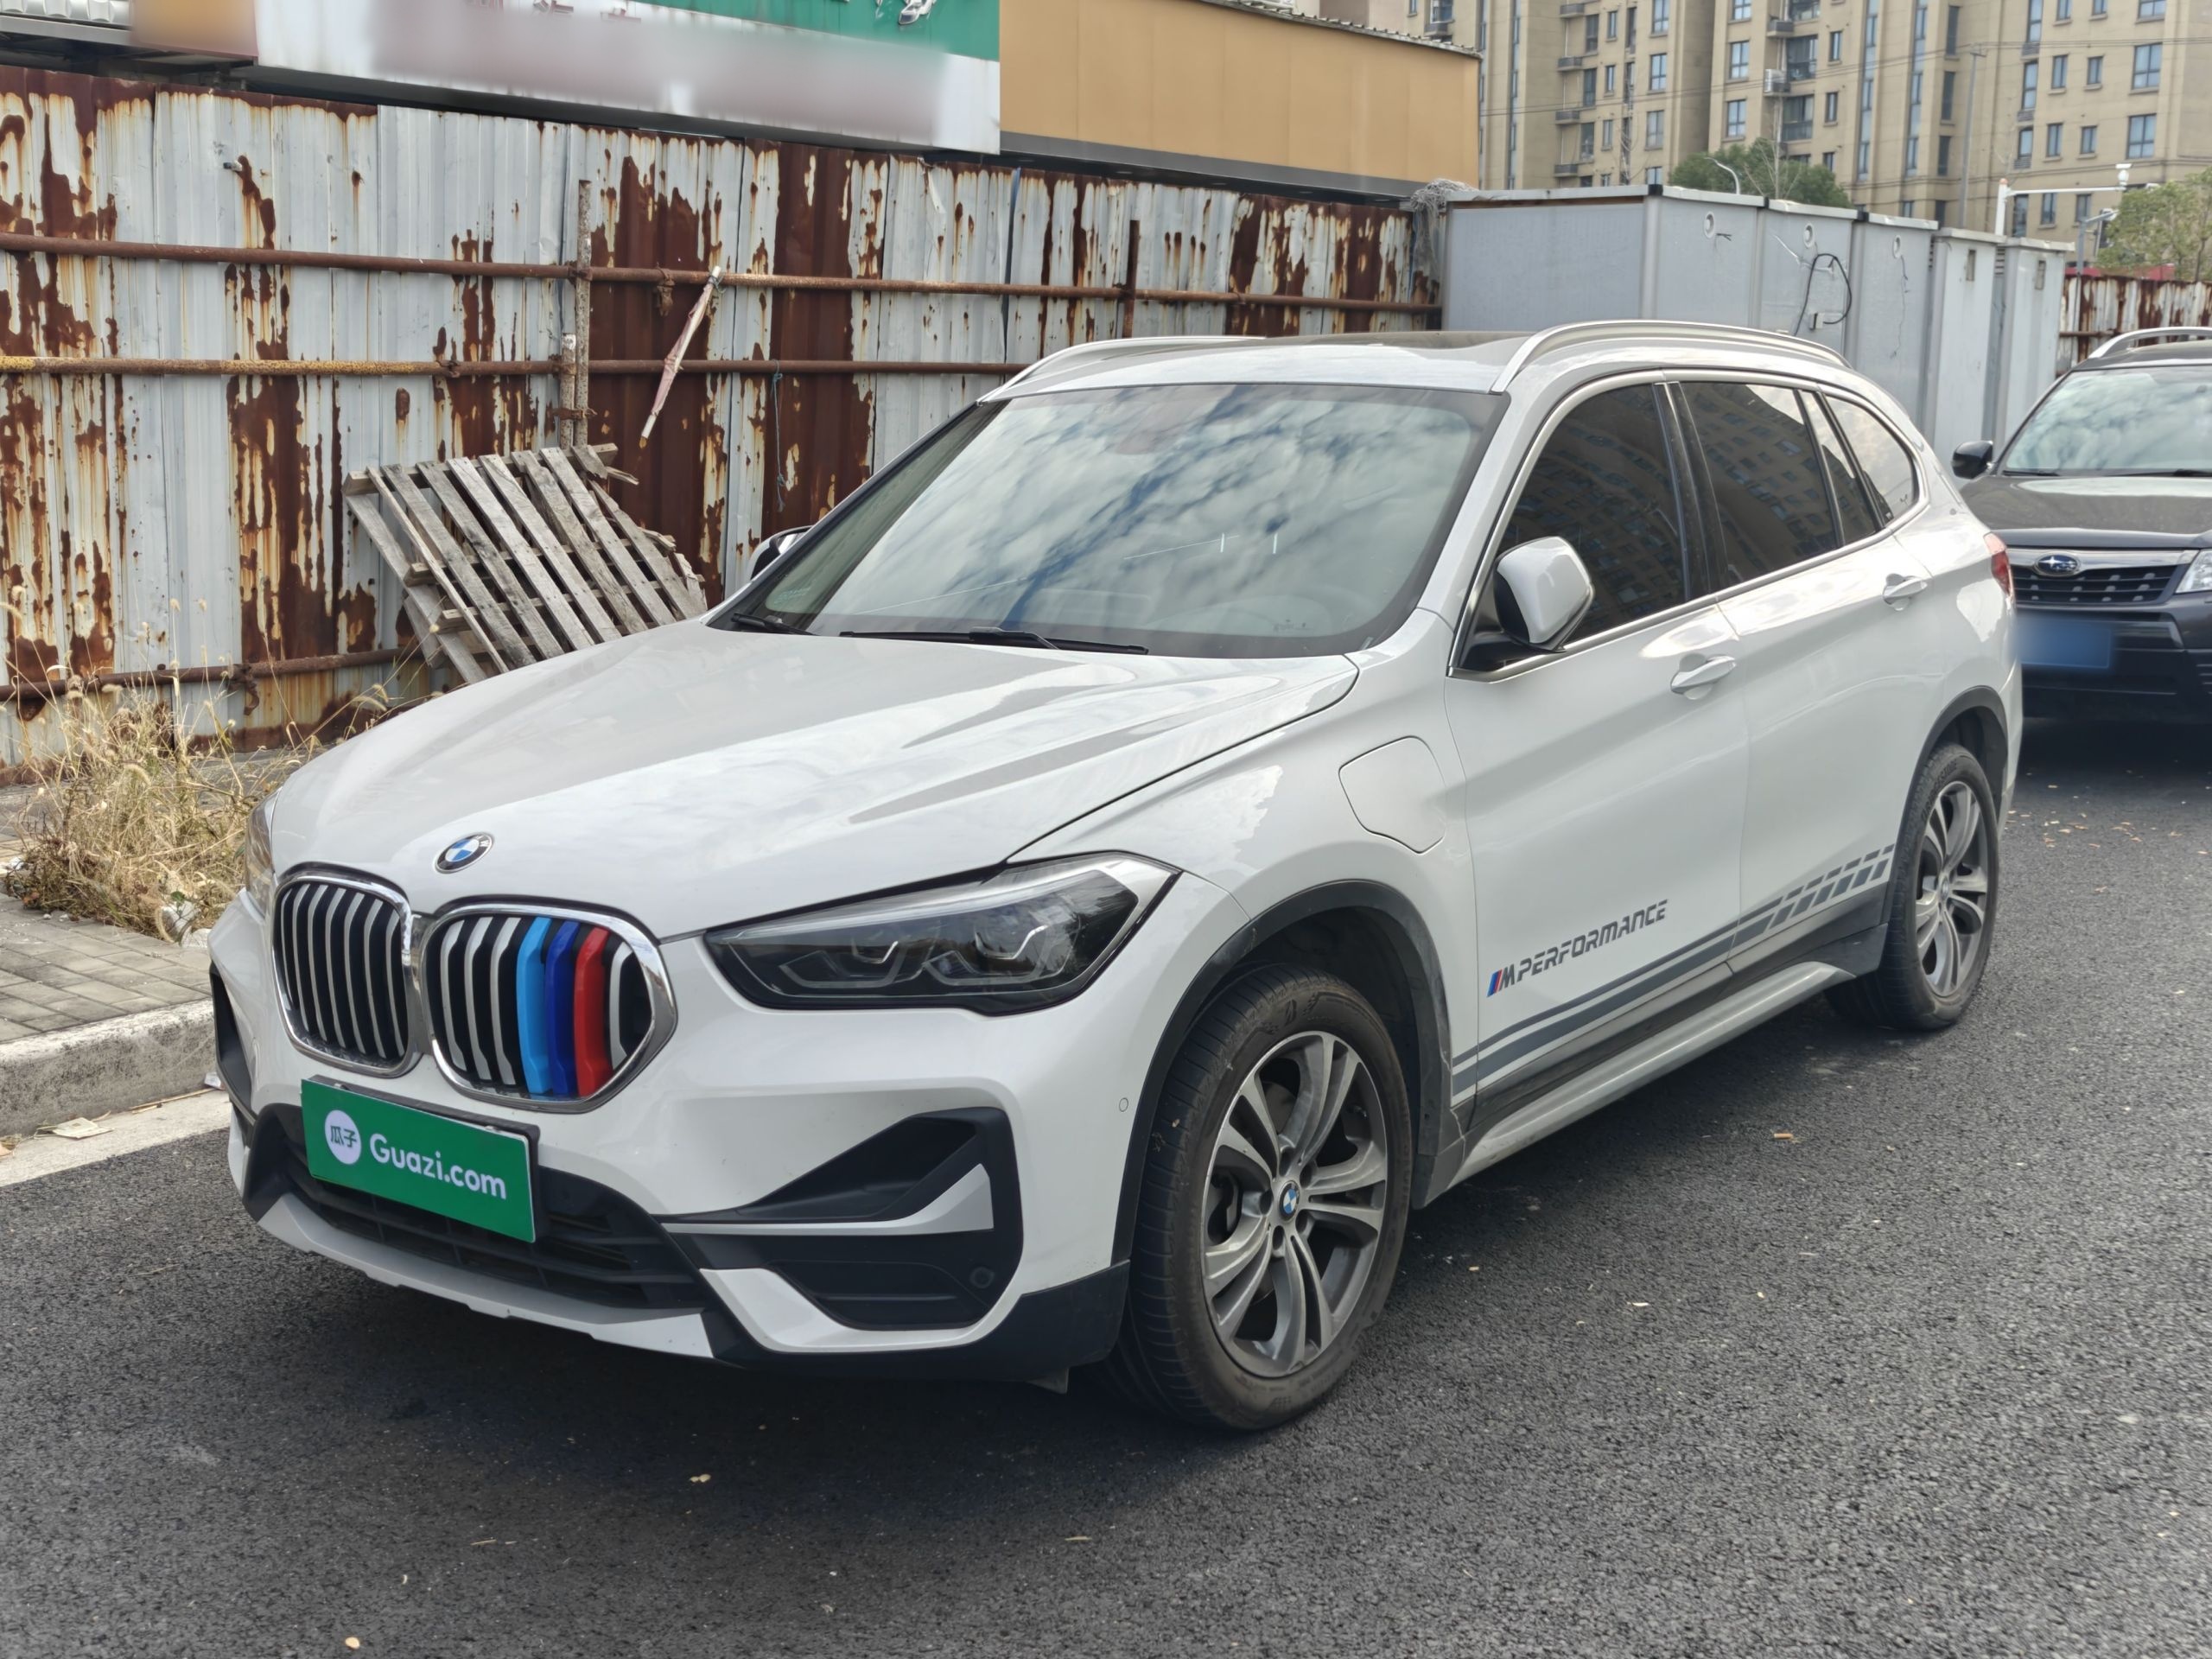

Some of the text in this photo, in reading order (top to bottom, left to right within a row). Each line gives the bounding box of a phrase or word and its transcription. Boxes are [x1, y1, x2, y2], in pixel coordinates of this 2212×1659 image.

[1516, 899, 1668, 982] PERFORMANCE
[329, 1125, 358, 1148] 瓜子
[369, 1133, 507, 1200] Guazi.com
